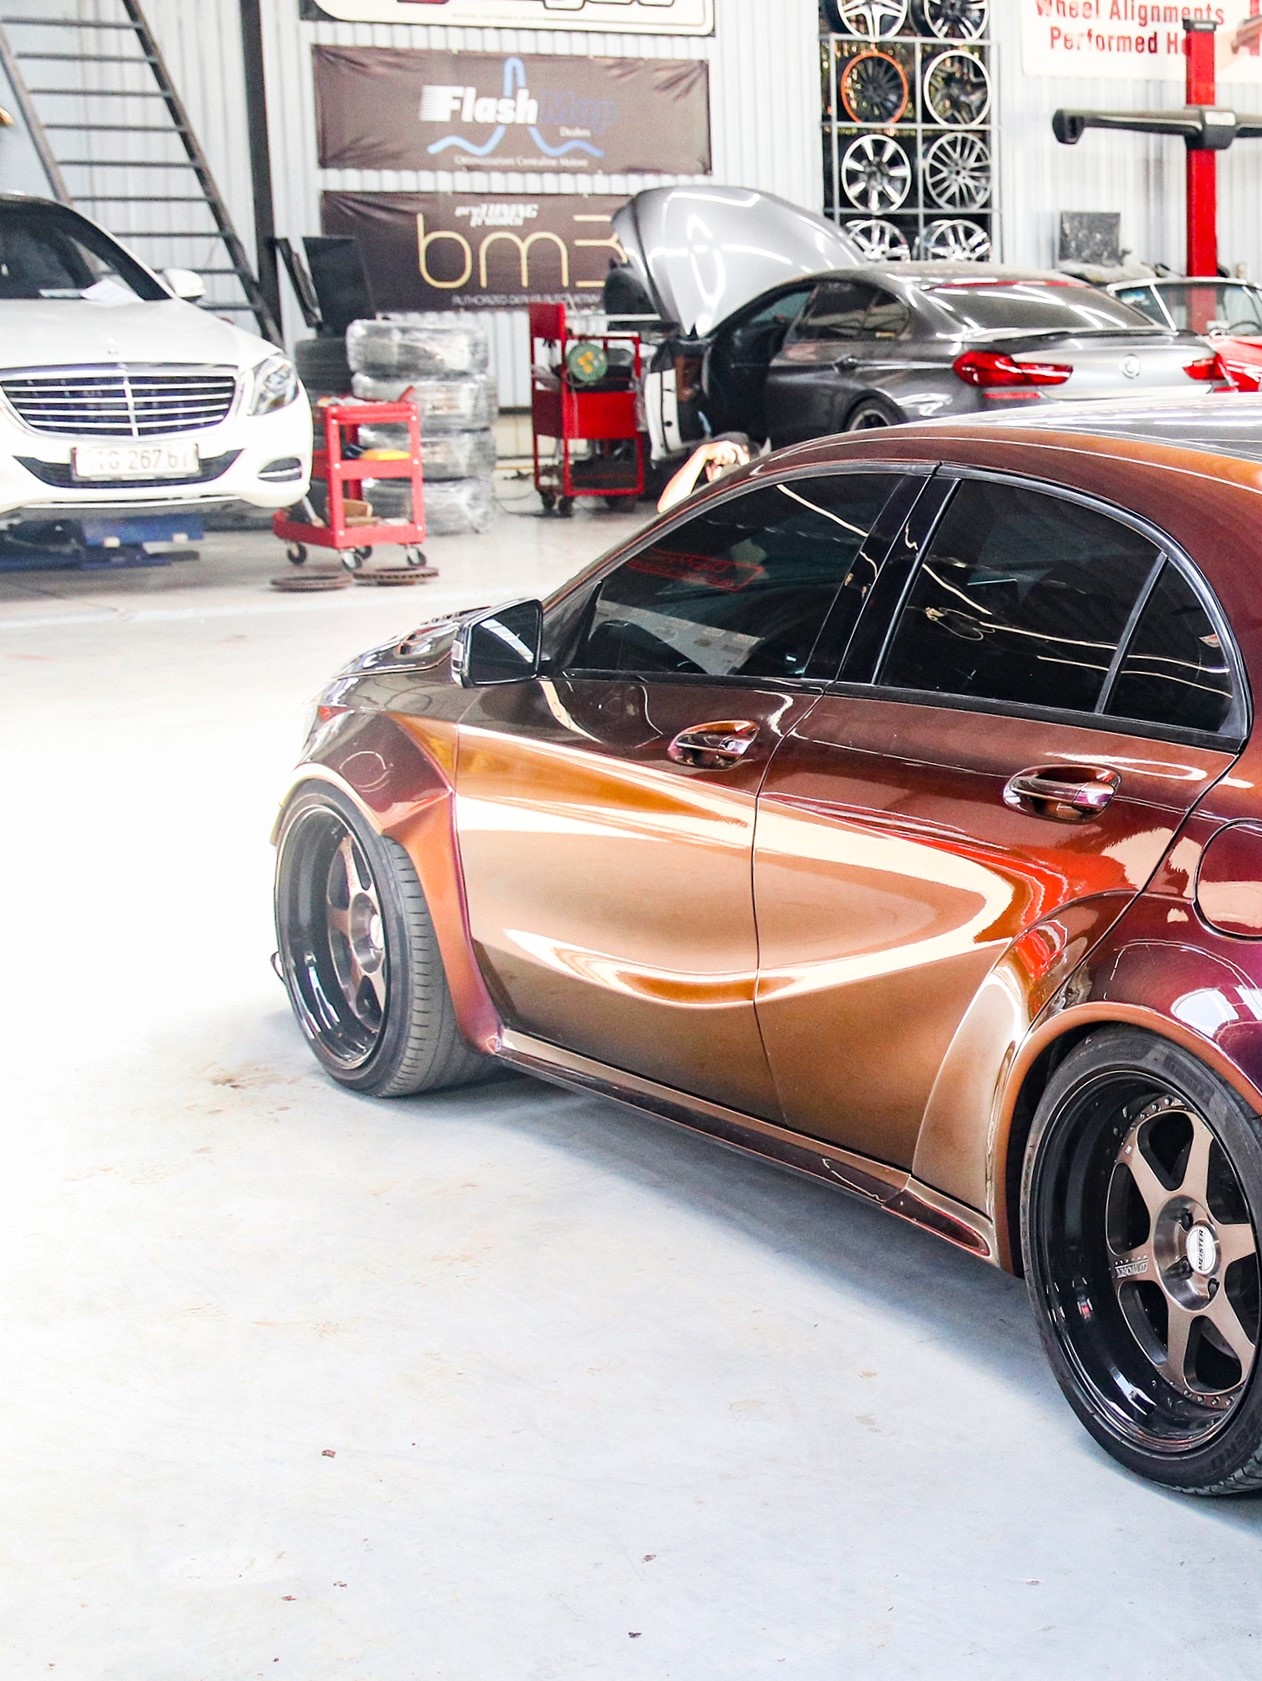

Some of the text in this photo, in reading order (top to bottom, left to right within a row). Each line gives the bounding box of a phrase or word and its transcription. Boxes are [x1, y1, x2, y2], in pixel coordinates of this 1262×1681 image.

[1109, 0, 1225, 26] Alignments
[1050, 27, 1158, 54] Performed
[1197, 1229, 1205, 1271] MEISTER
